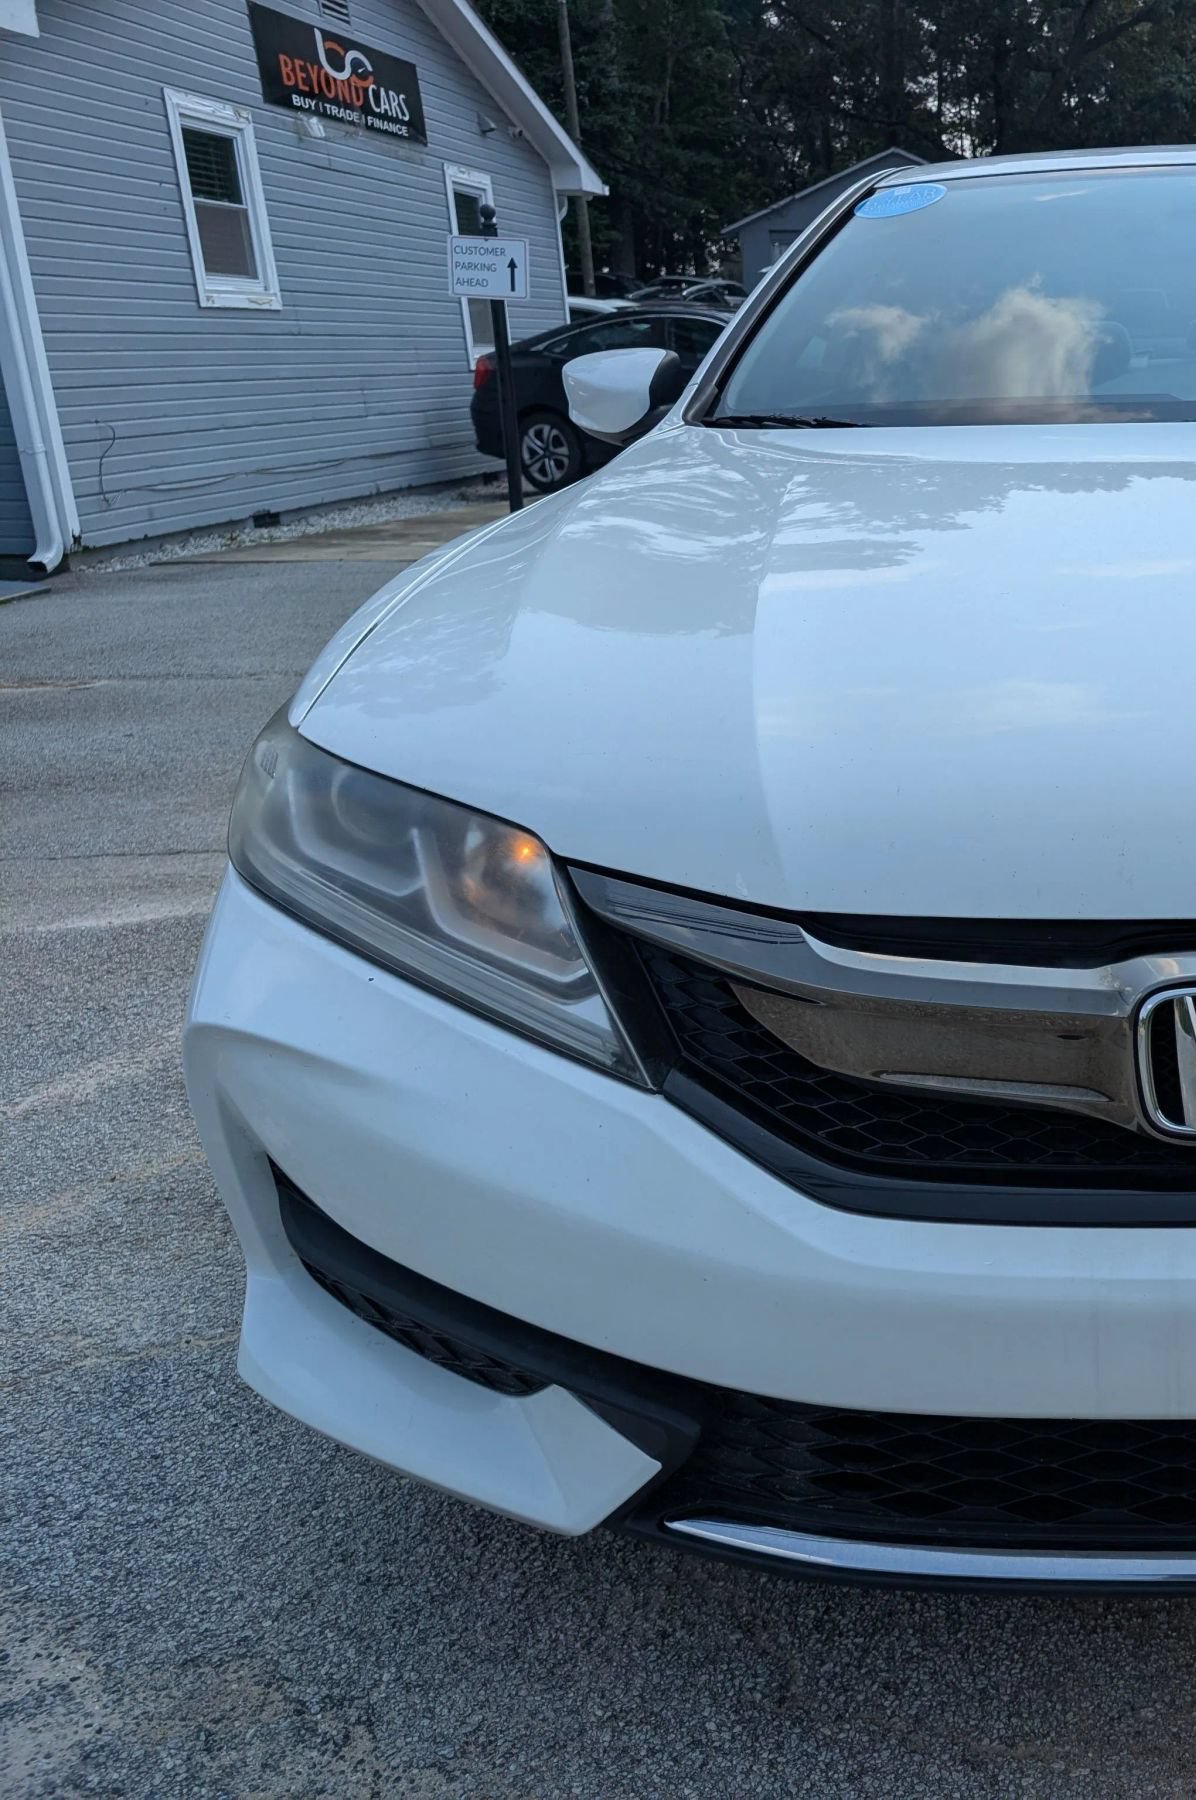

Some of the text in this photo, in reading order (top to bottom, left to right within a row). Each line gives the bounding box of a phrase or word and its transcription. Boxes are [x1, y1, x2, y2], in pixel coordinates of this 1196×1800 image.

[278, 53, 410, 121] BEYOND CARS
[291, 94, 316, 111] BUY
[324, 103, 361, 122] TRADE
[367, 115, 409, 137] FINANCE
[454, 245, 506, 256] CUSTOMER
[455, 261, 497, 272] PARKING
[455, 277, 489, 288] AHEAD
